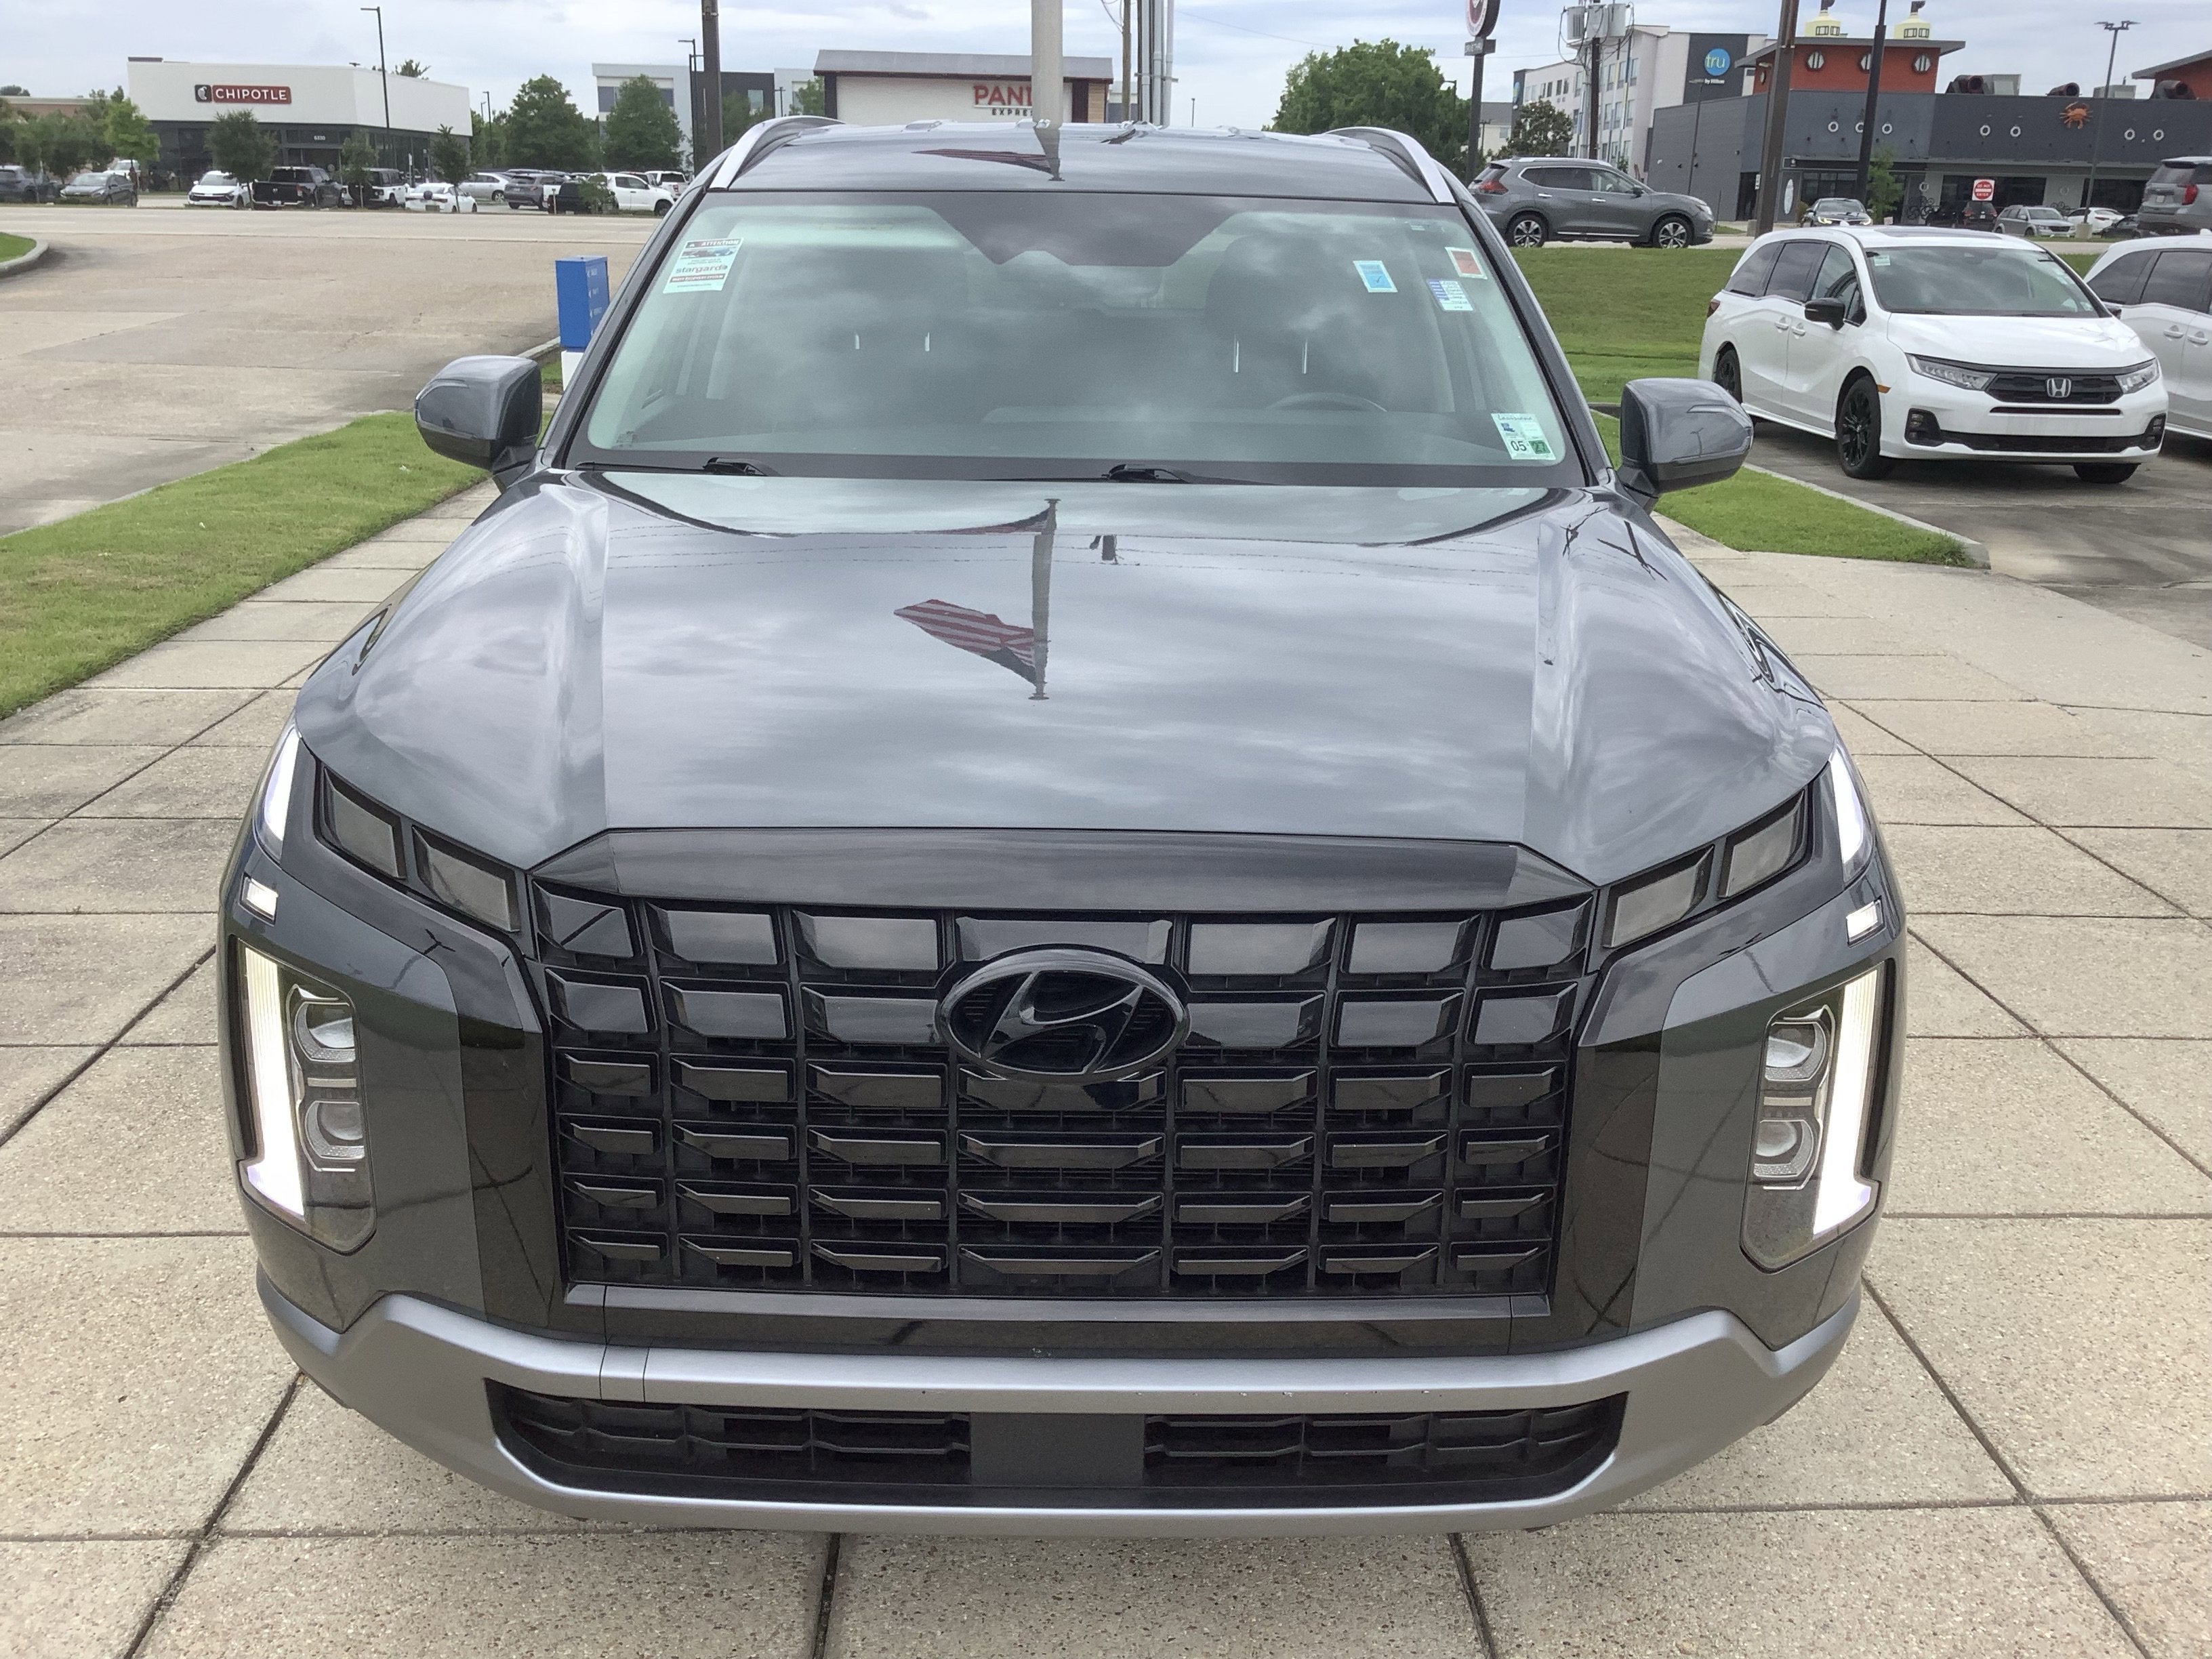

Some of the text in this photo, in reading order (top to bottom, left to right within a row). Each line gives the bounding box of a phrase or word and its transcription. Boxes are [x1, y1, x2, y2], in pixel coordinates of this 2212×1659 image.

[1706, 54, 1725, 68] tru
[215, 88, 287, 100] CHIPOTLE
[973, 85, 1032, 106] PAN
[991, 108, 1032, 117] EXPRE
[1511, 441, 1527, 451] 05
[1531, 441, 1547, 453] 27
